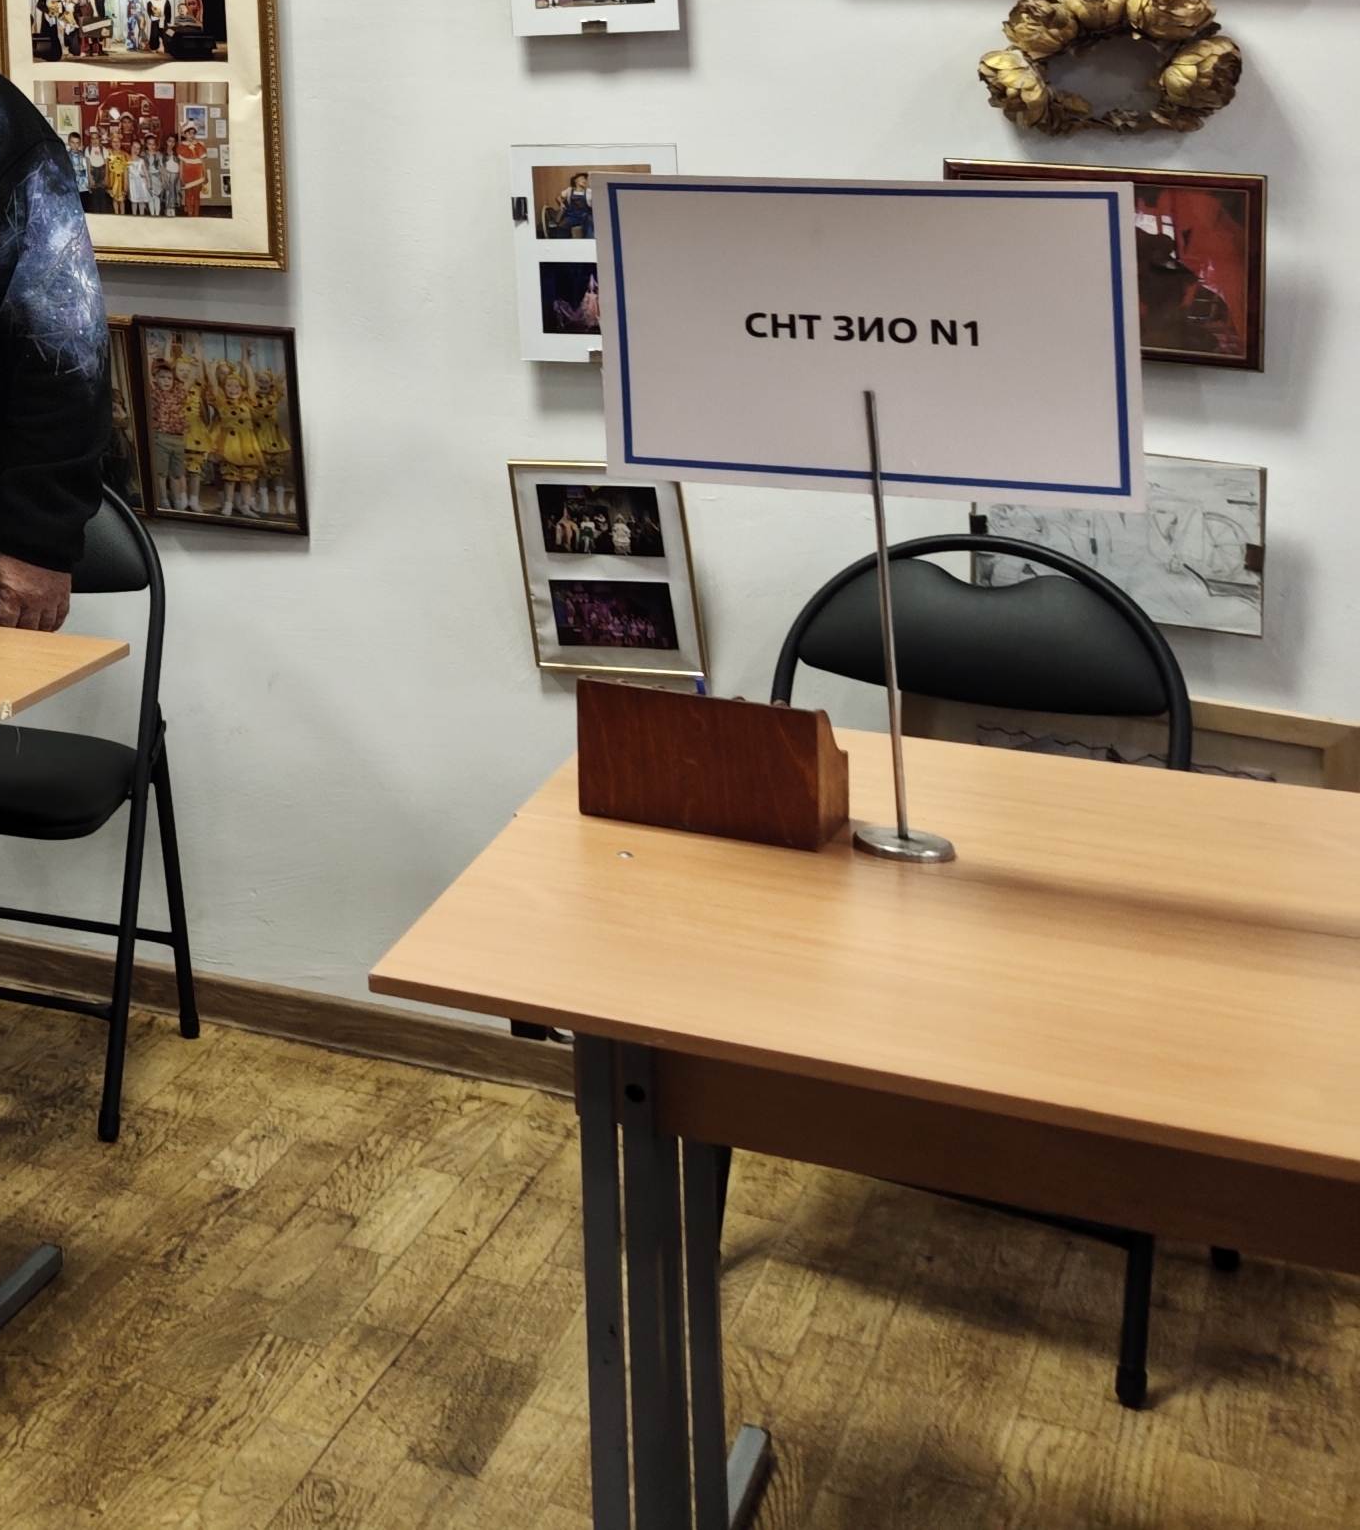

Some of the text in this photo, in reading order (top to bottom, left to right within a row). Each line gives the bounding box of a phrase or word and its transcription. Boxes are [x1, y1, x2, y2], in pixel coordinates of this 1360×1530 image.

[744, 311, 980, 347] СНТ ЗИО N1
